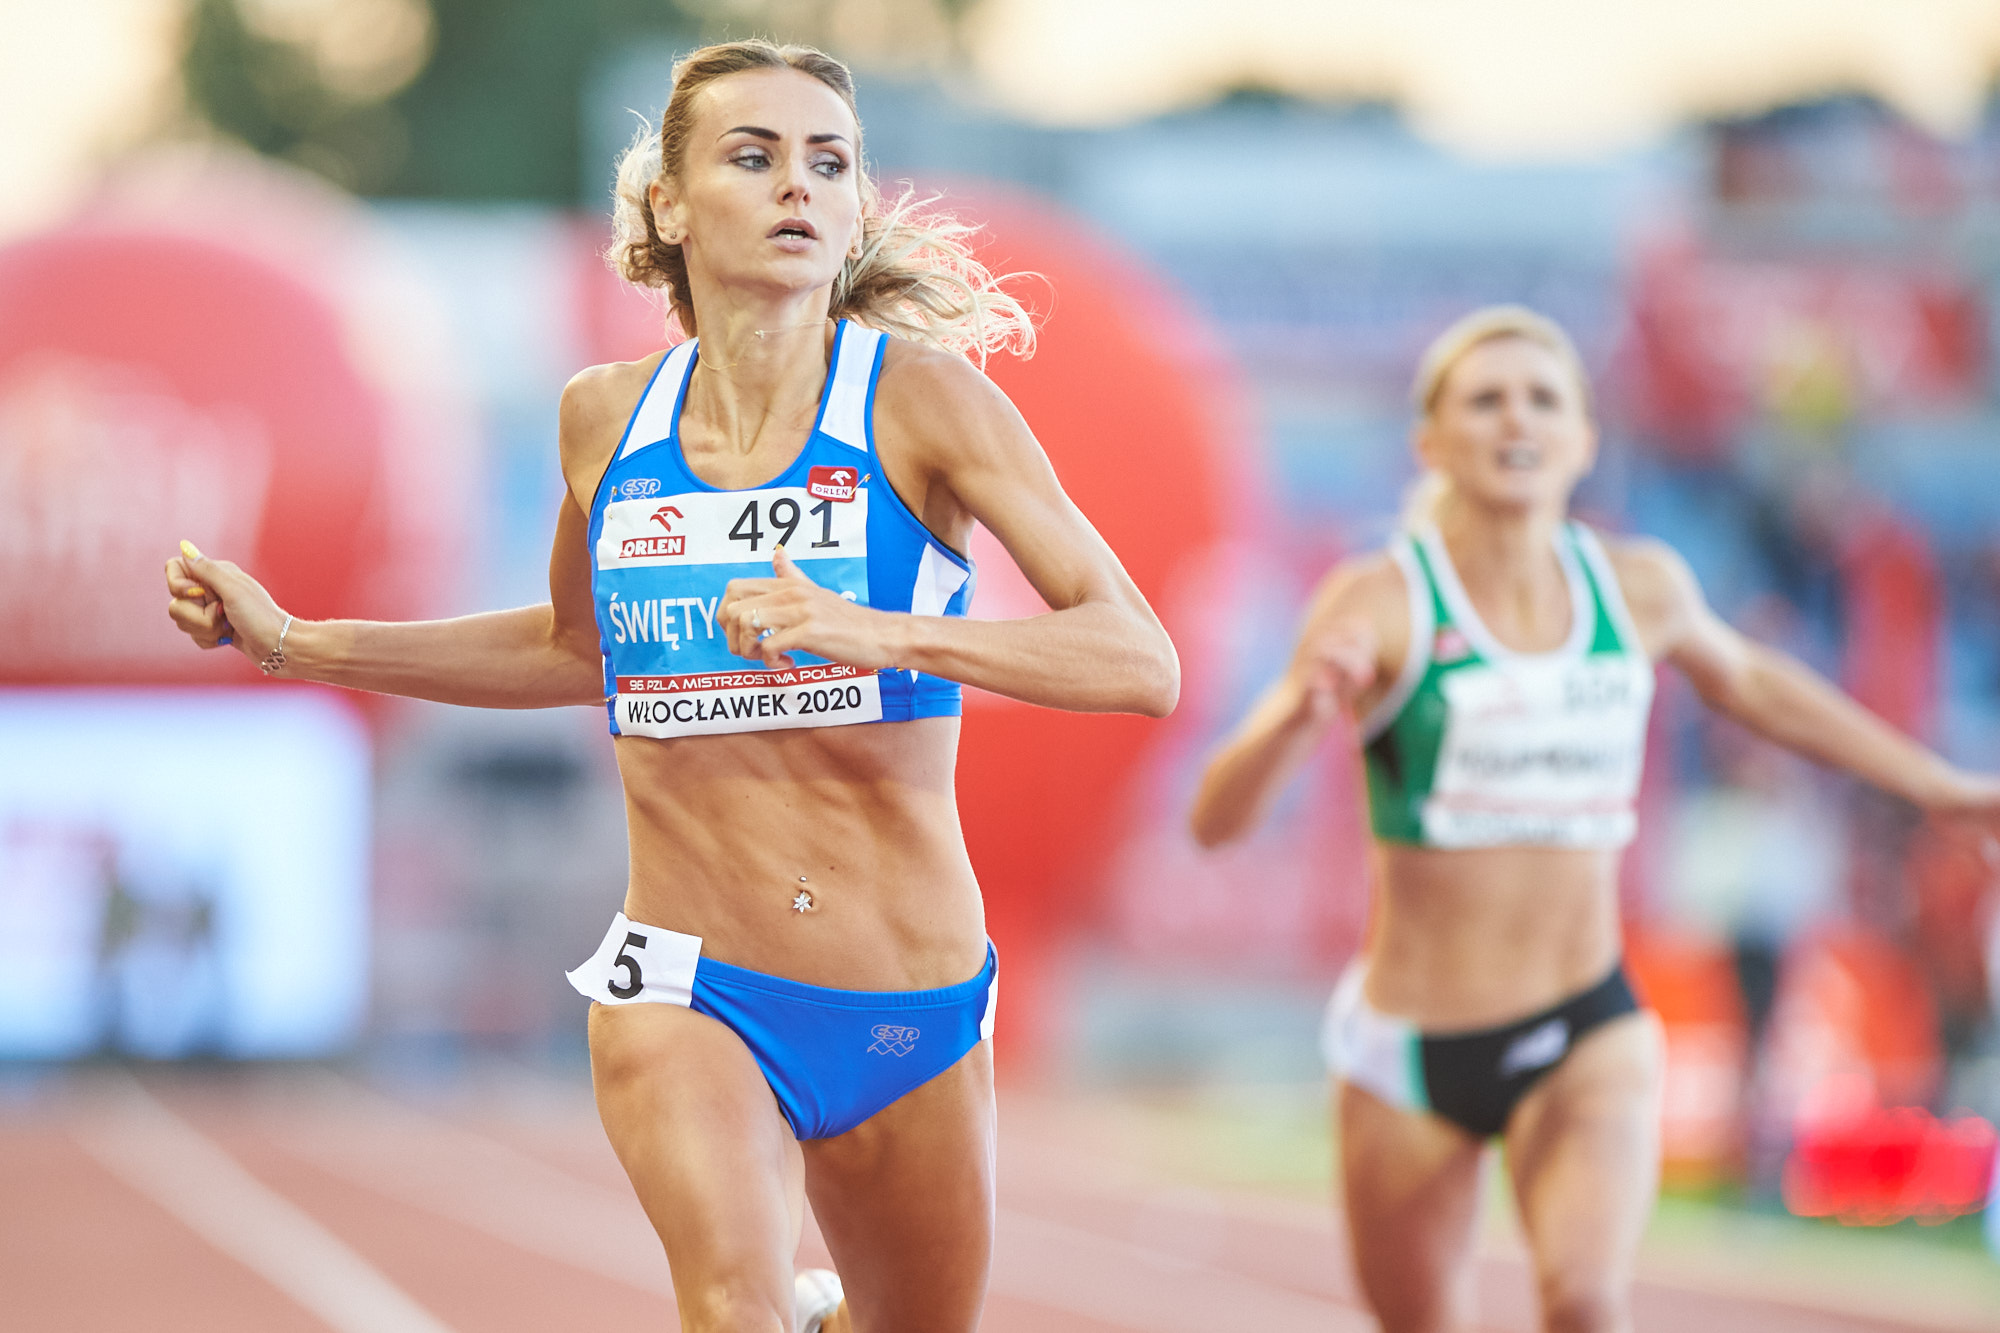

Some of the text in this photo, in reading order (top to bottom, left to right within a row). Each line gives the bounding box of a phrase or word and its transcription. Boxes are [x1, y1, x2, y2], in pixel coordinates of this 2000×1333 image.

[815, 486, 849, 496] ORLEN
[728, 497, 839, 552] 491
[623, 538, 682, 557] ORLEN
[647, 680, 679, 691] PZLA
[682, 673, 797, 689] MISTRZOSTWA
[800, 665, 857, 682] POLSKI
[628, 685, 862, 723] WŁOCŁAWEK 2020
[607, 932, 648, 999] 5
